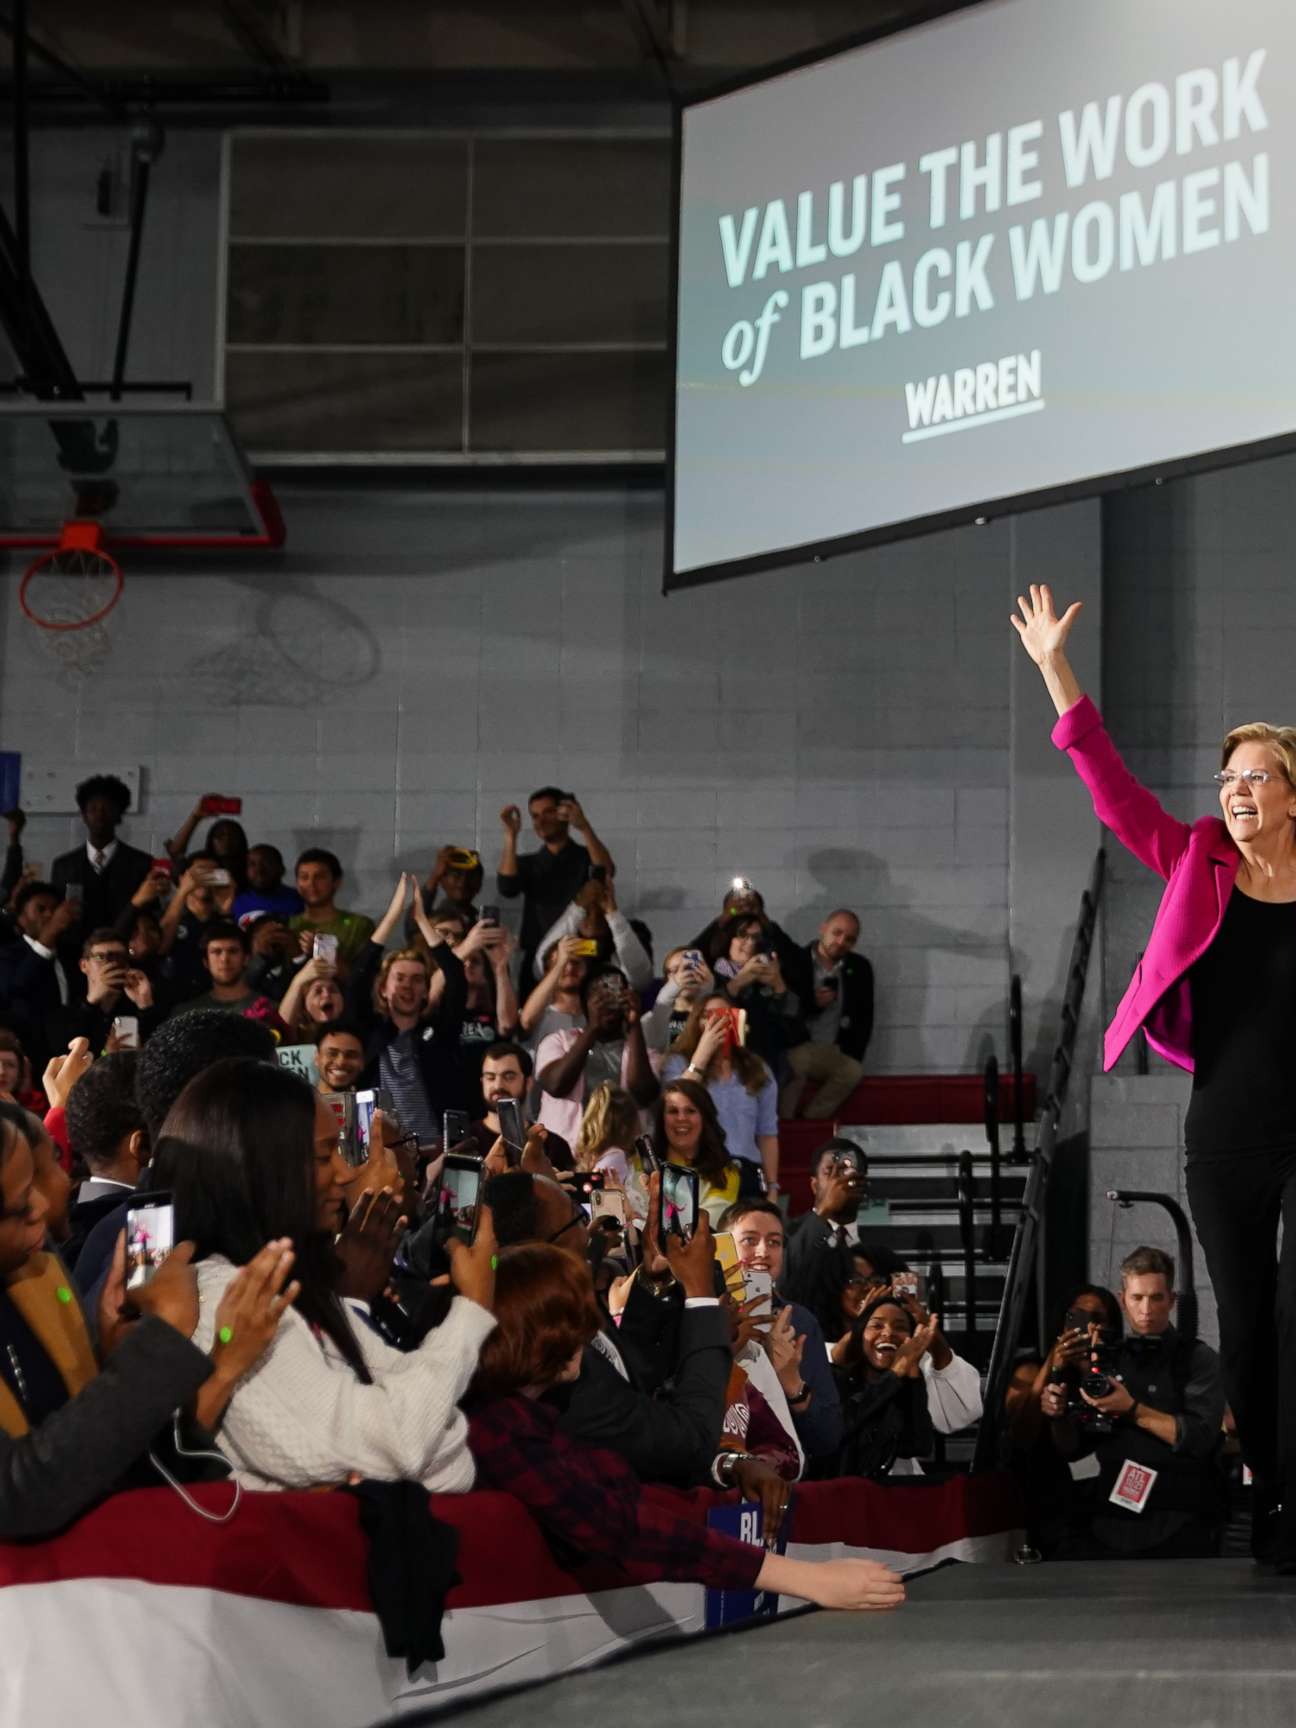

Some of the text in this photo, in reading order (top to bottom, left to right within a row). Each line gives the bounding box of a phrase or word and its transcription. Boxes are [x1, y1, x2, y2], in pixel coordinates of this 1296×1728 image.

[719, 49, 1269, 288] VALUE THE WORK
[721, 152, 1270, 387] of BLACK WOMEN
[905, 349, 1041, 429] WARREN
[740, 1510, 765, 1548] BL
